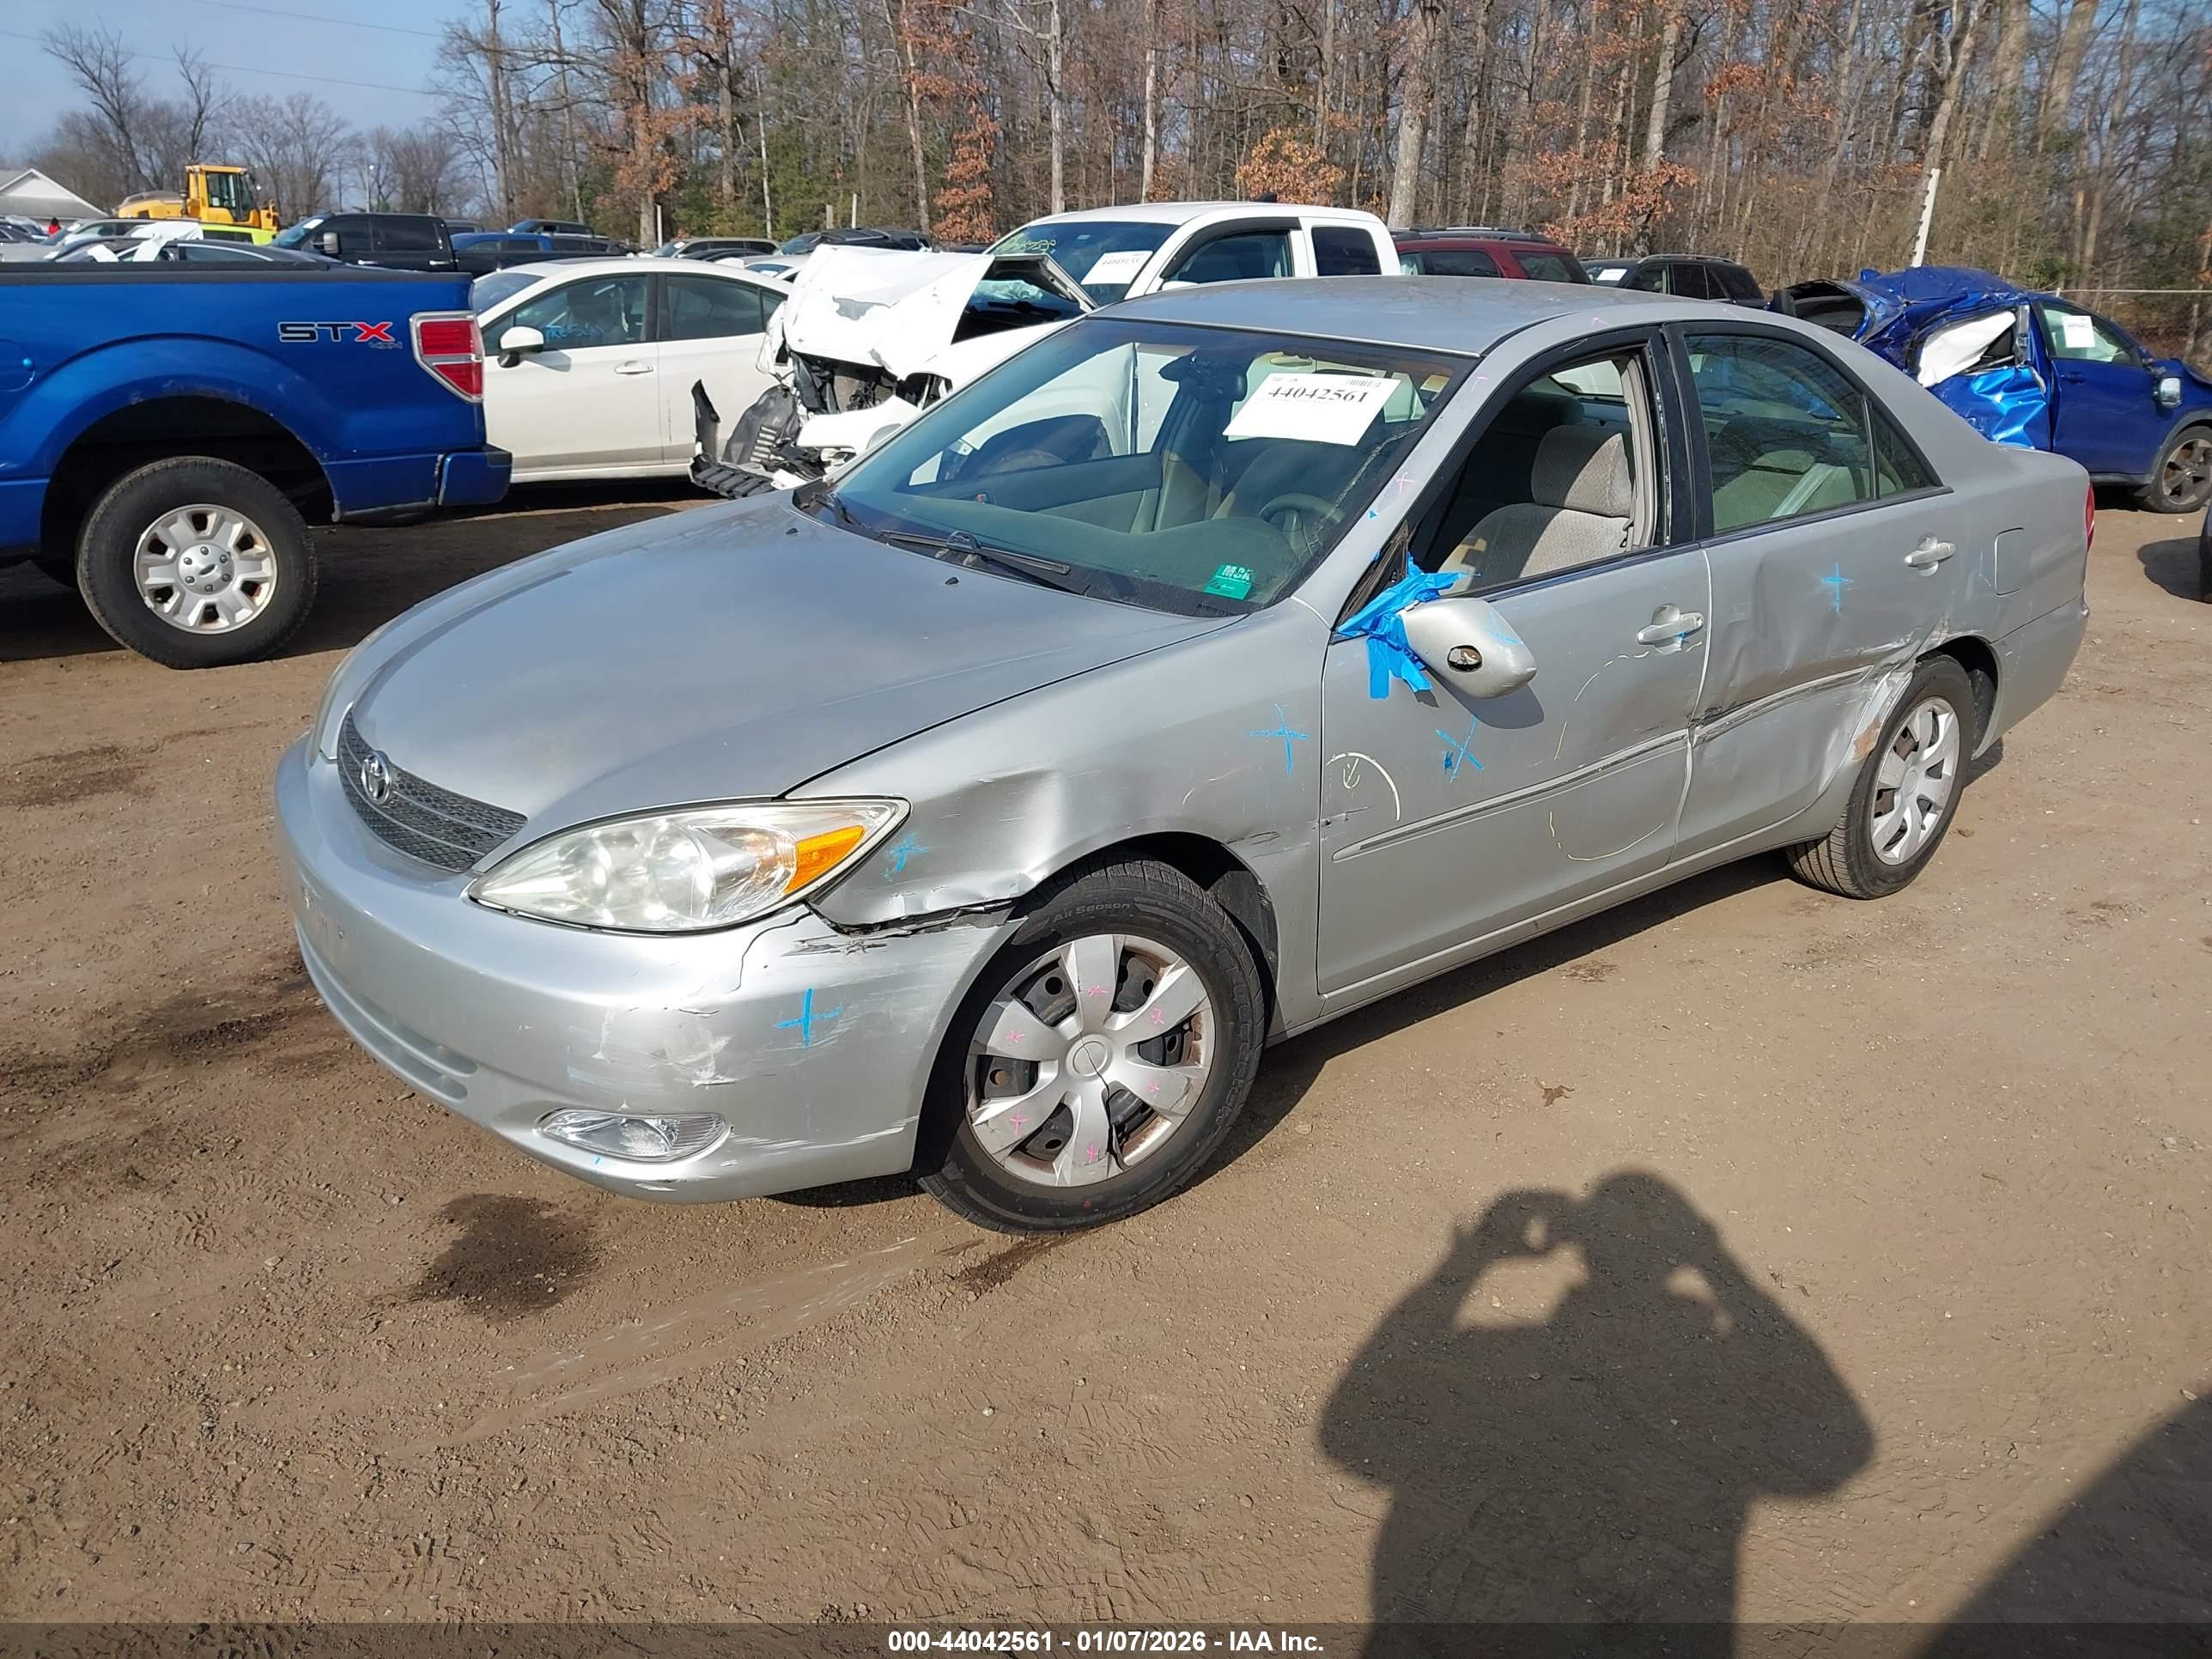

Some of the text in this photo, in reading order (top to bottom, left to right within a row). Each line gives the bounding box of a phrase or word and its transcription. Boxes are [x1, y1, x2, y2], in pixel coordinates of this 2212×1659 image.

[278, 321, 395, 343] STX
[1268, 386, 1369, 404] 44042561
[1053, 908, 1073, 923] All
[1075, 902, 1131, 915] Season
